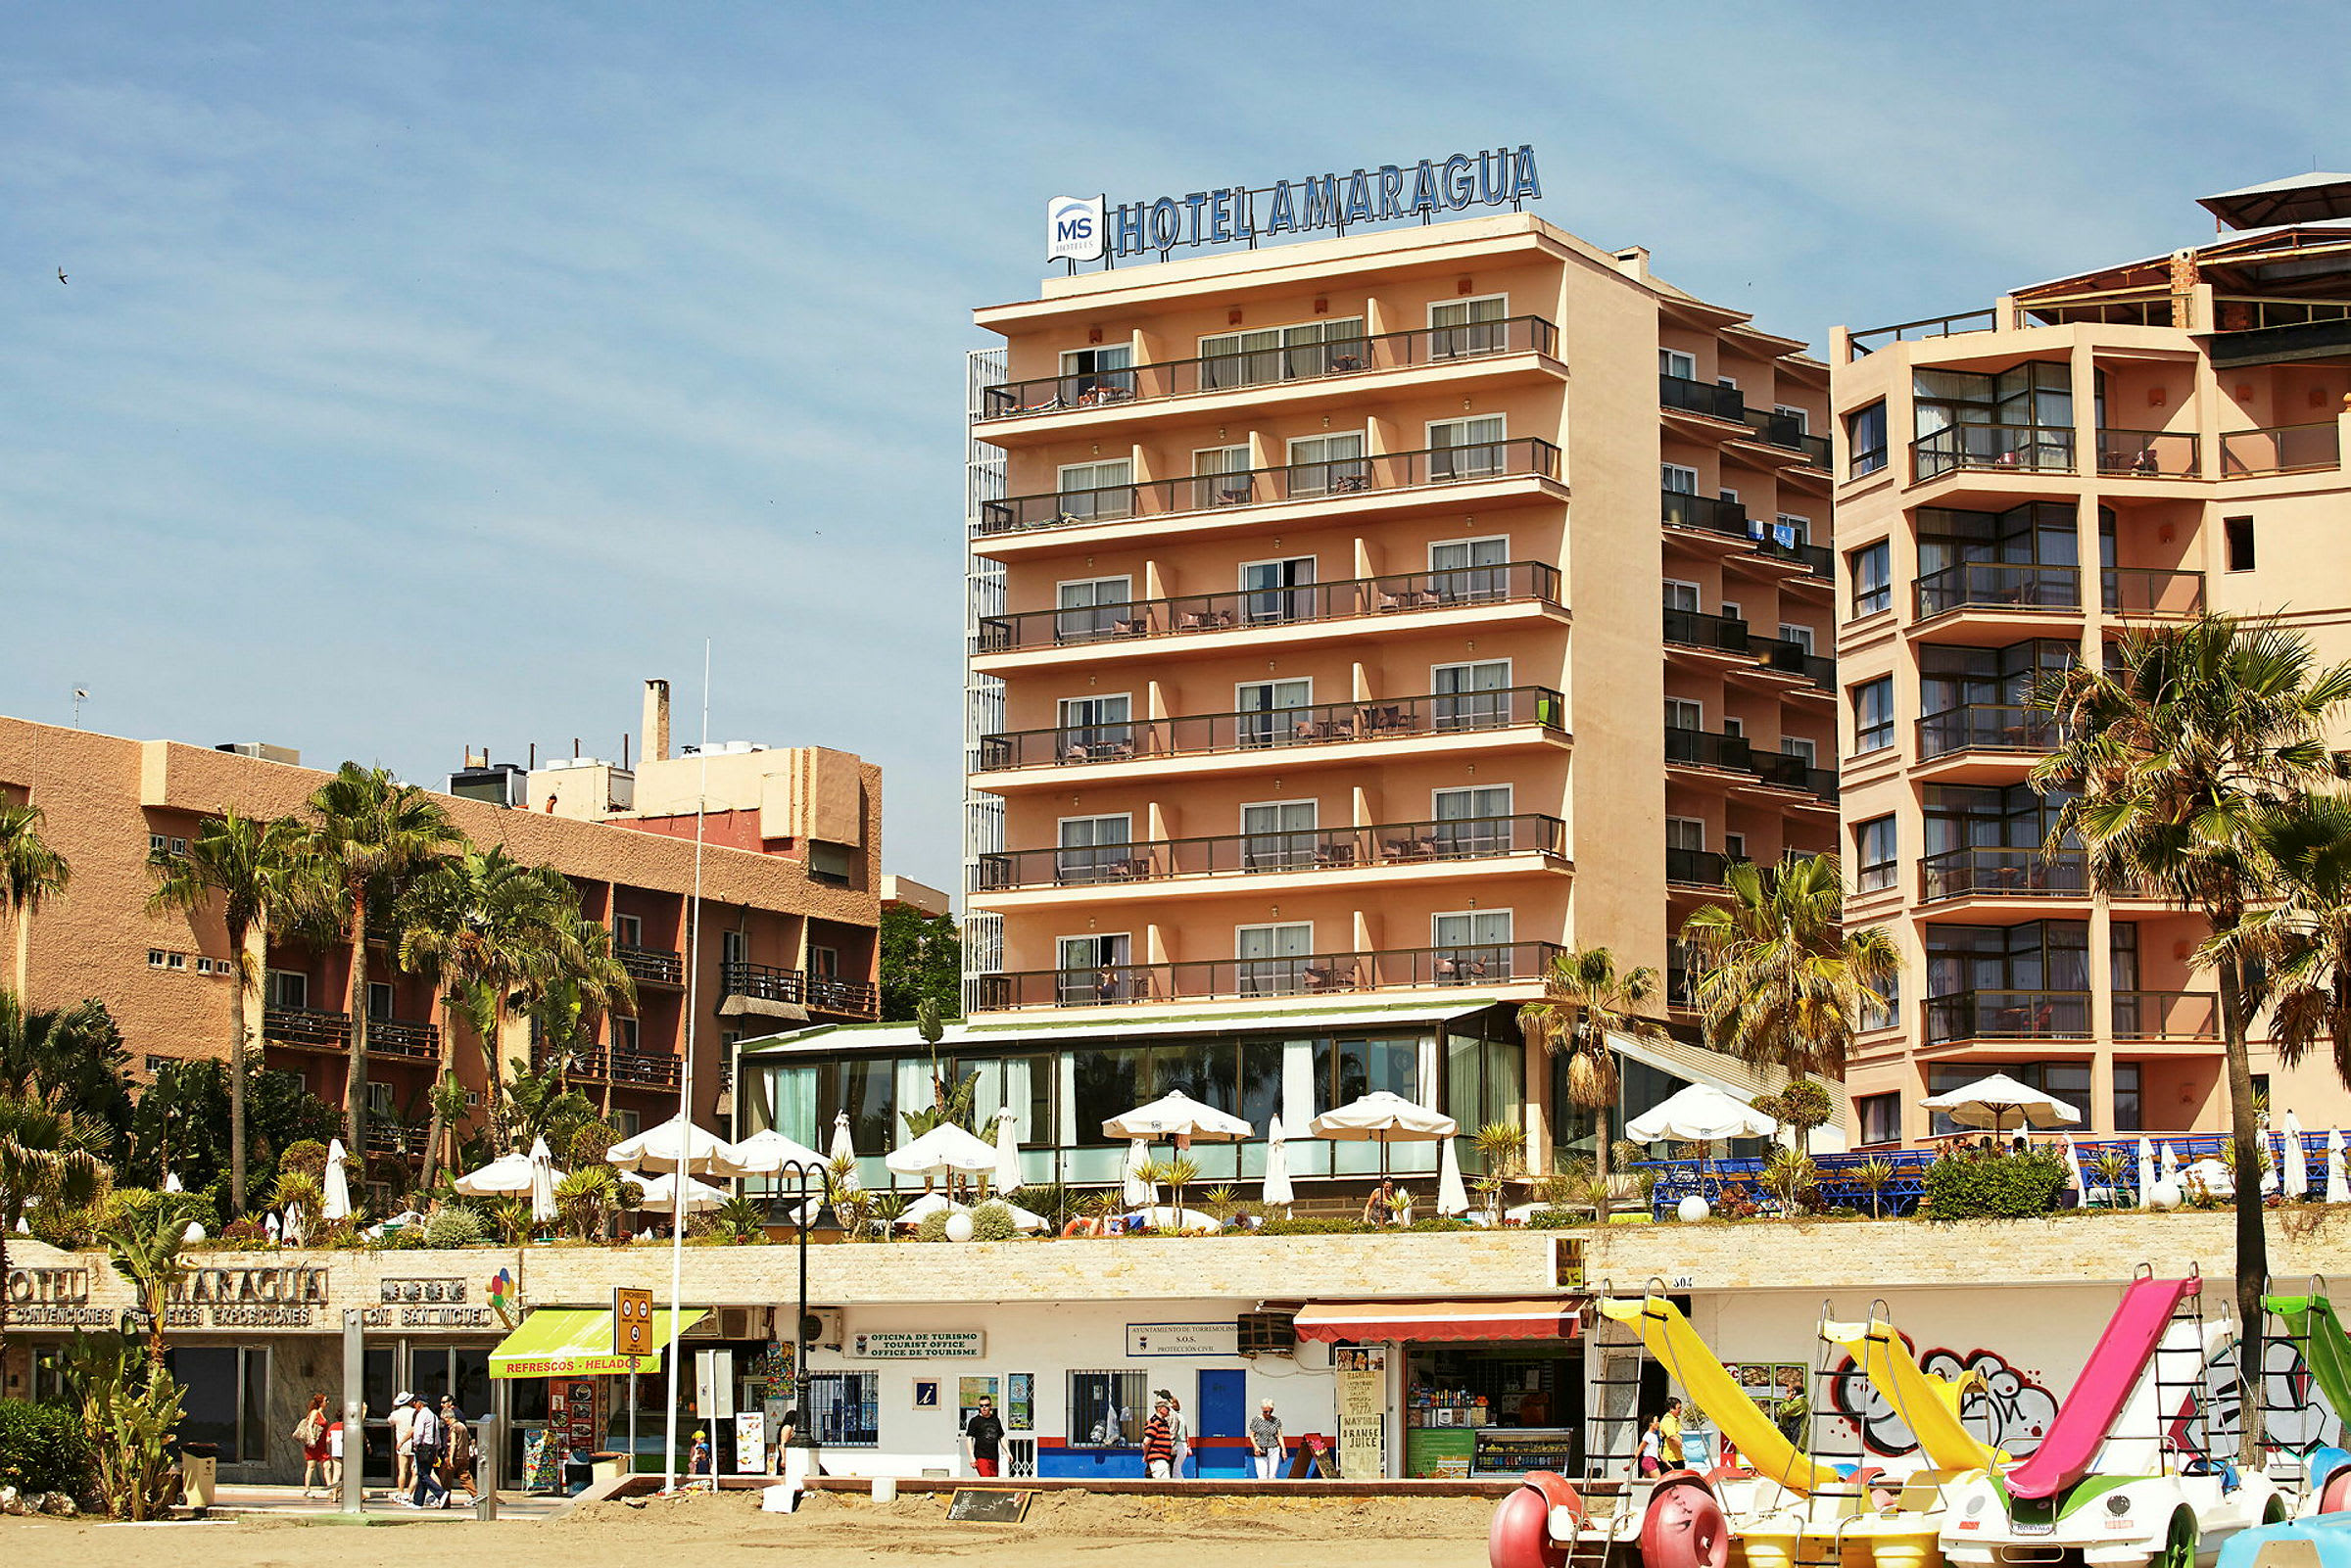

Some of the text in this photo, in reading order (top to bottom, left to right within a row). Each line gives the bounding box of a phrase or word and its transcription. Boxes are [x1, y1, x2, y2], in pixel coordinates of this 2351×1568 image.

[1117, 144, 1542, 258] HOTEL AMARAGUA
[1057, 217, 1092, 242] MS
[8, 1268, 86, 1304] OTEL
[15, 1308, 114, 1324] CONVENCIONES
[213, 1308, 312, 1325] EXPOSICIONES
[402, 1308, 429, 1325] SAN
[439, 1308, 491, 1325] MIGUEL
[506, 1361, 574, 1373] REFRESCOS
[1350, 1438, 1376, 1448] JUICE
